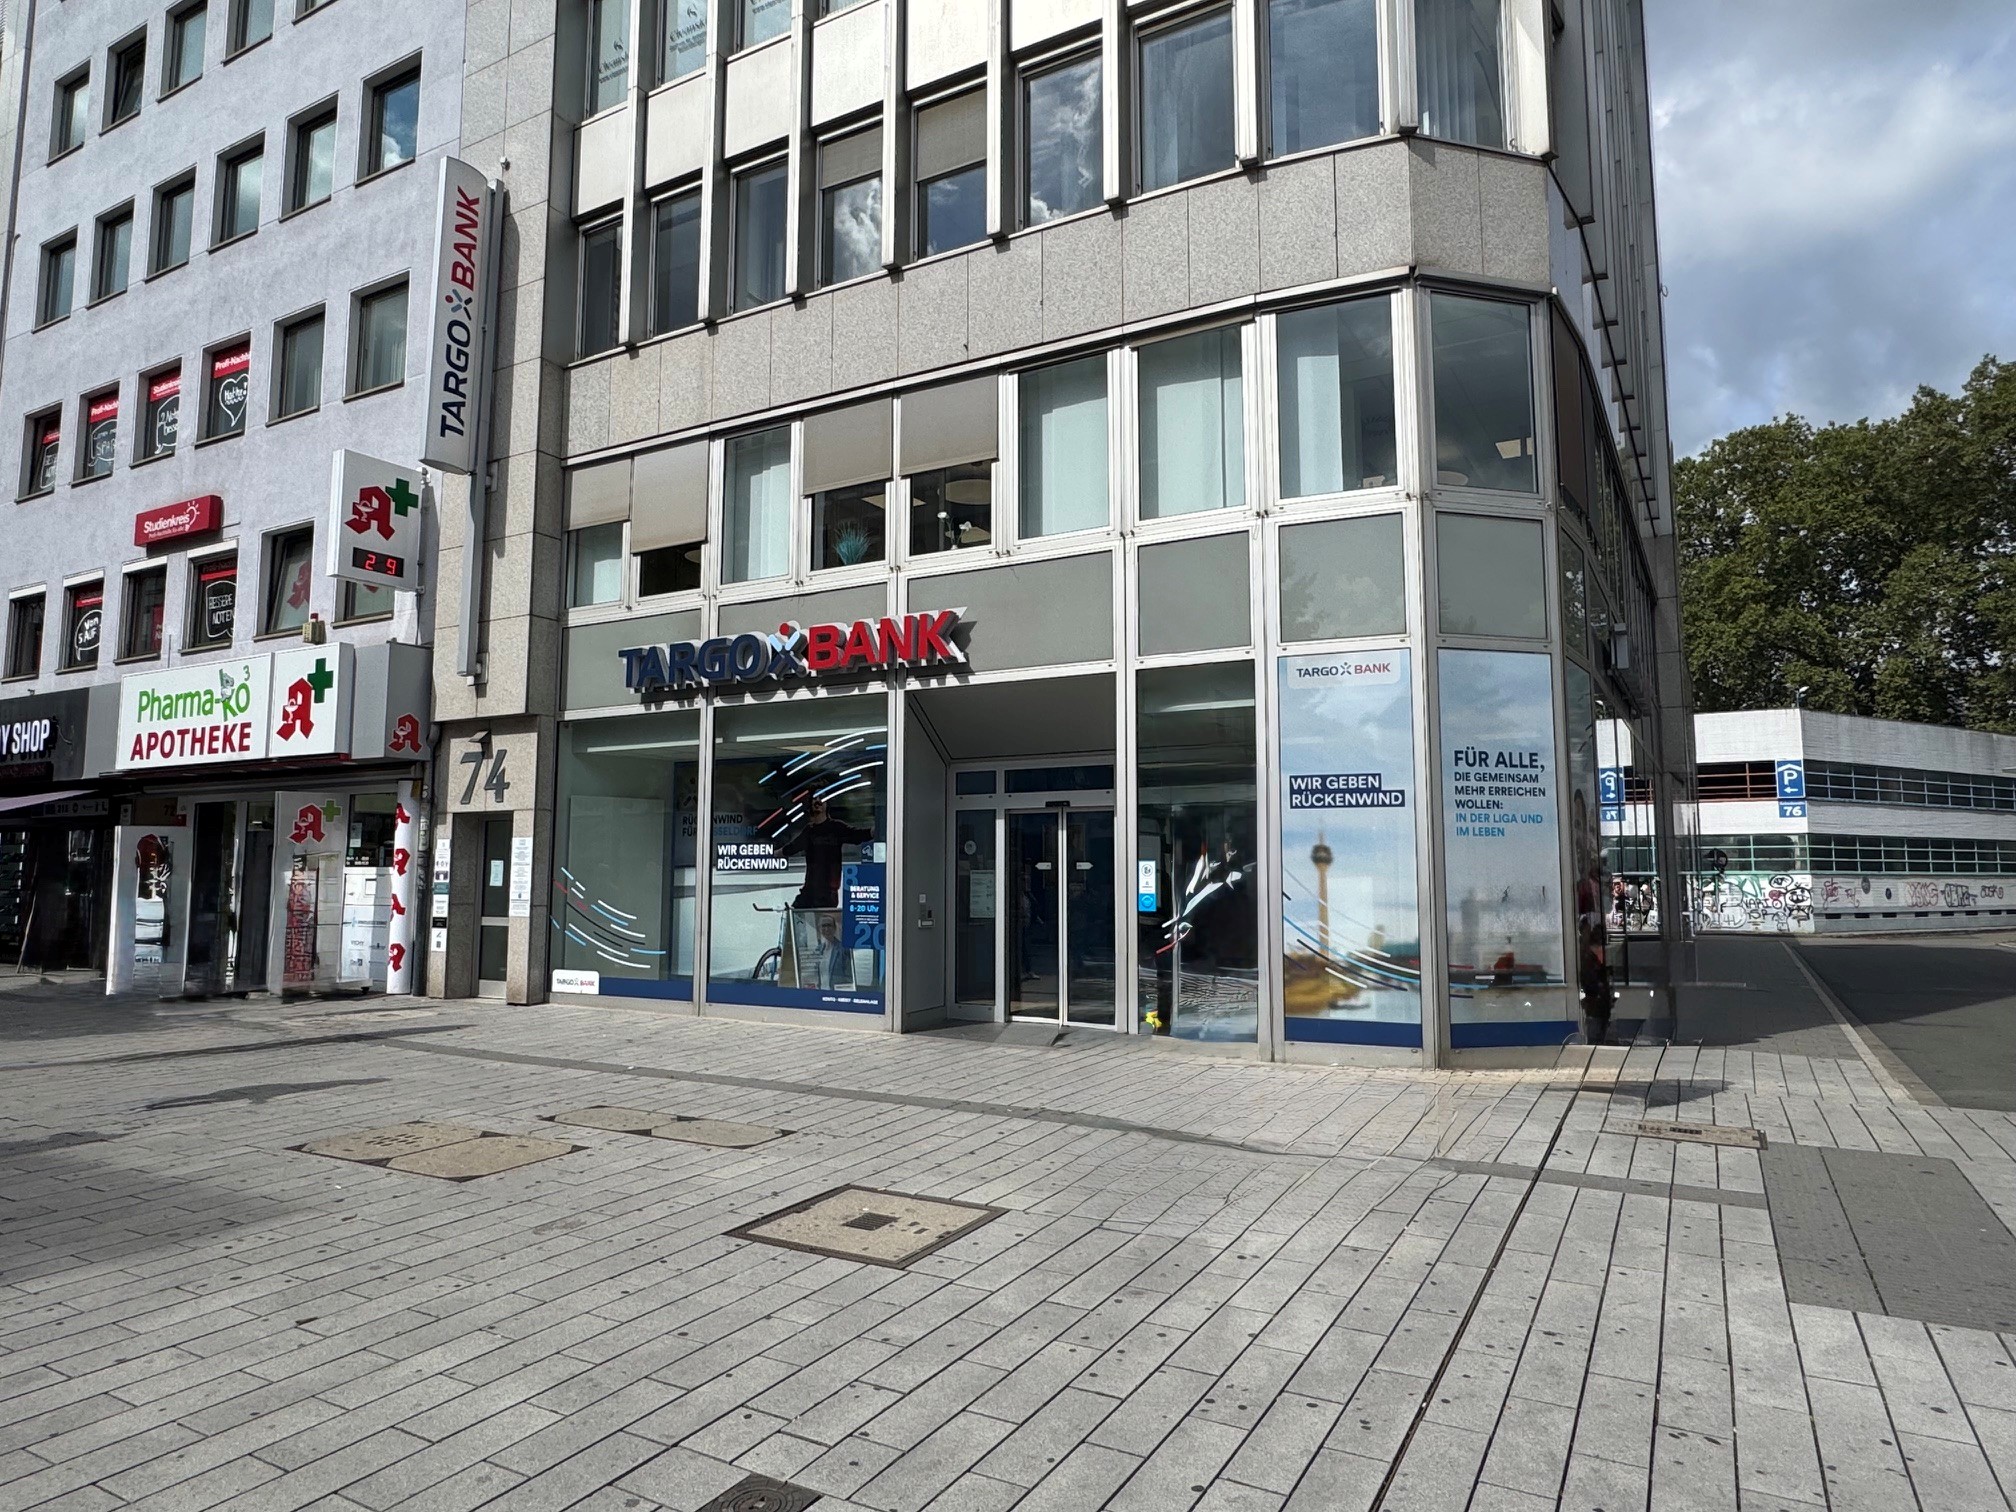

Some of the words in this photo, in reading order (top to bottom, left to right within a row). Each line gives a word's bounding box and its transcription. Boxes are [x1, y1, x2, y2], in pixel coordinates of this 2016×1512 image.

[143, 512, 191, 534] Studienkreis
[12, 718, 50, 754] SHOP
[130, 722, 252, 761] APOTHEKE
[1454, 746, 1488, 768] FÜR
[1494, 751, 1546, 772] ALLE,
[460, 748, 510, 806] 74
[1291, 778, 1322, 790] WIR
[1326, 776, 1380, 789] GEBEN
[1454, 772, 1472, 782] DIE
[1474, 772, 1539, 784] GEMEINSAM
[1292, 790, 1403, 808] RÜCKENWIND
[1454, 786, 1486, 796] MEHR
[1489, 787, 1546, 798] ERREICHEN
[1455, 799, 1504, 810] WOLLEN:
[1784, 806, 1802, 816] 76
[1456, 812, 1467, 822] IN
[1469, 812, 1490, 822] DER
[1493, 813, 1518, 823] LIGA
[1520, 814, 1543, 824] UND
[1456, 826, 1470, 836] IM
[1472, 826, 1506, 837] LEBEN
[718, 844, 737, 856] WIR
[739, 844, 774, 855] GEBEN
[717, 856, 788, 870] RÜCKENWIND
